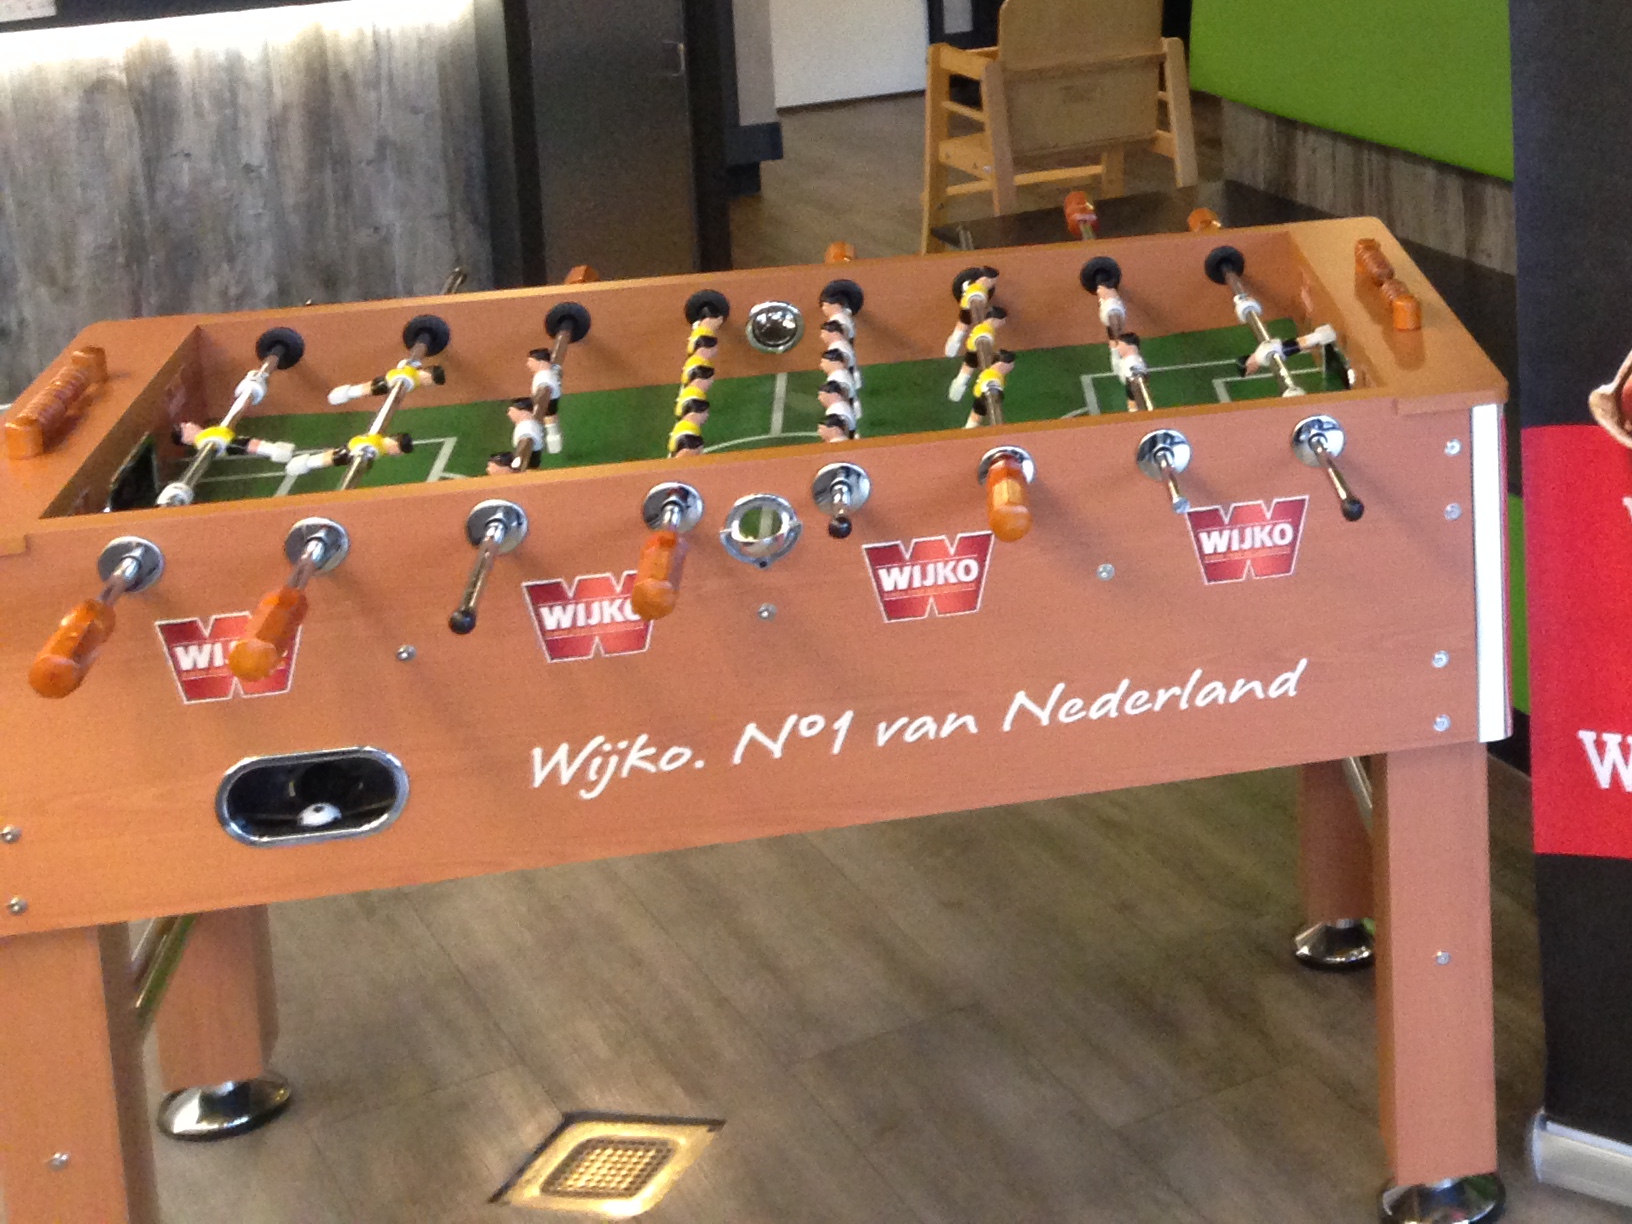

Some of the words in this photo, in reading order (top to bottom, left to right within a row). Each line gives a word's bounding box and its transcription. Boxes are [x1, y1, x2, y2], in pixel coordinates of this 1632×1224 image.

[1198, 522, 1294, 555] WIJKO
[877, 558, 980, 592] WIJKO
[530, 733, 706, 800] Wijko.
[875, 711, 979, 747] van
[1002, 657, 1308, 733] Nederland
